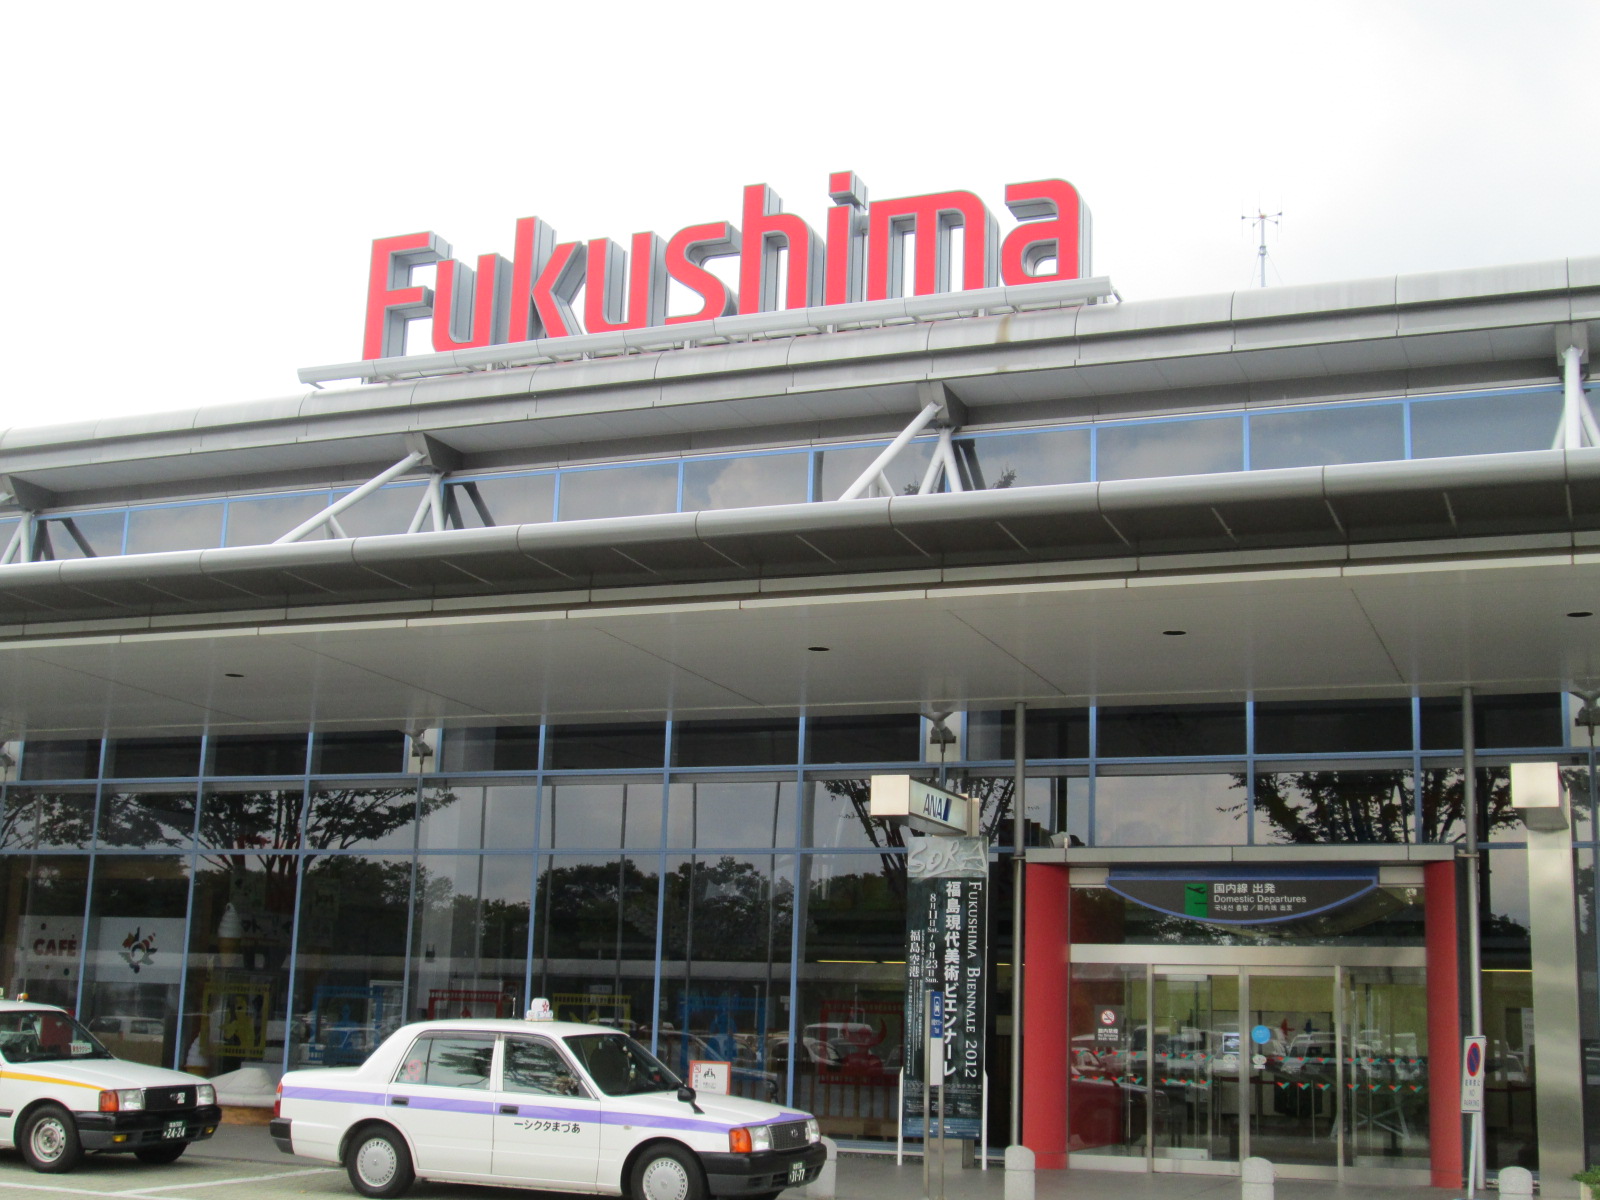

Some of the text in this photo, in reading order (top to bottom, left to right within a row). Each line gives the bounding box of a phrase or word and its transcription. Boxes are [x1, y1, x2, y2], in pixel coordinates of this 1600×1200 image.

[361, 170, 1087, 362] Fukushima
[923, 793, 943, 820] ANA
[1213, 883, 1276, 894] 国内線 出発
[1213, 894, 1307, 904] Domestic Departures
[909, 929, 921, 978] 福島空港
[943, 881, 962, 1077] 福島現代美術ビエンナーレ
[965, 881, 982, 1078] FUKUSHIMA BIENNALE 2012
